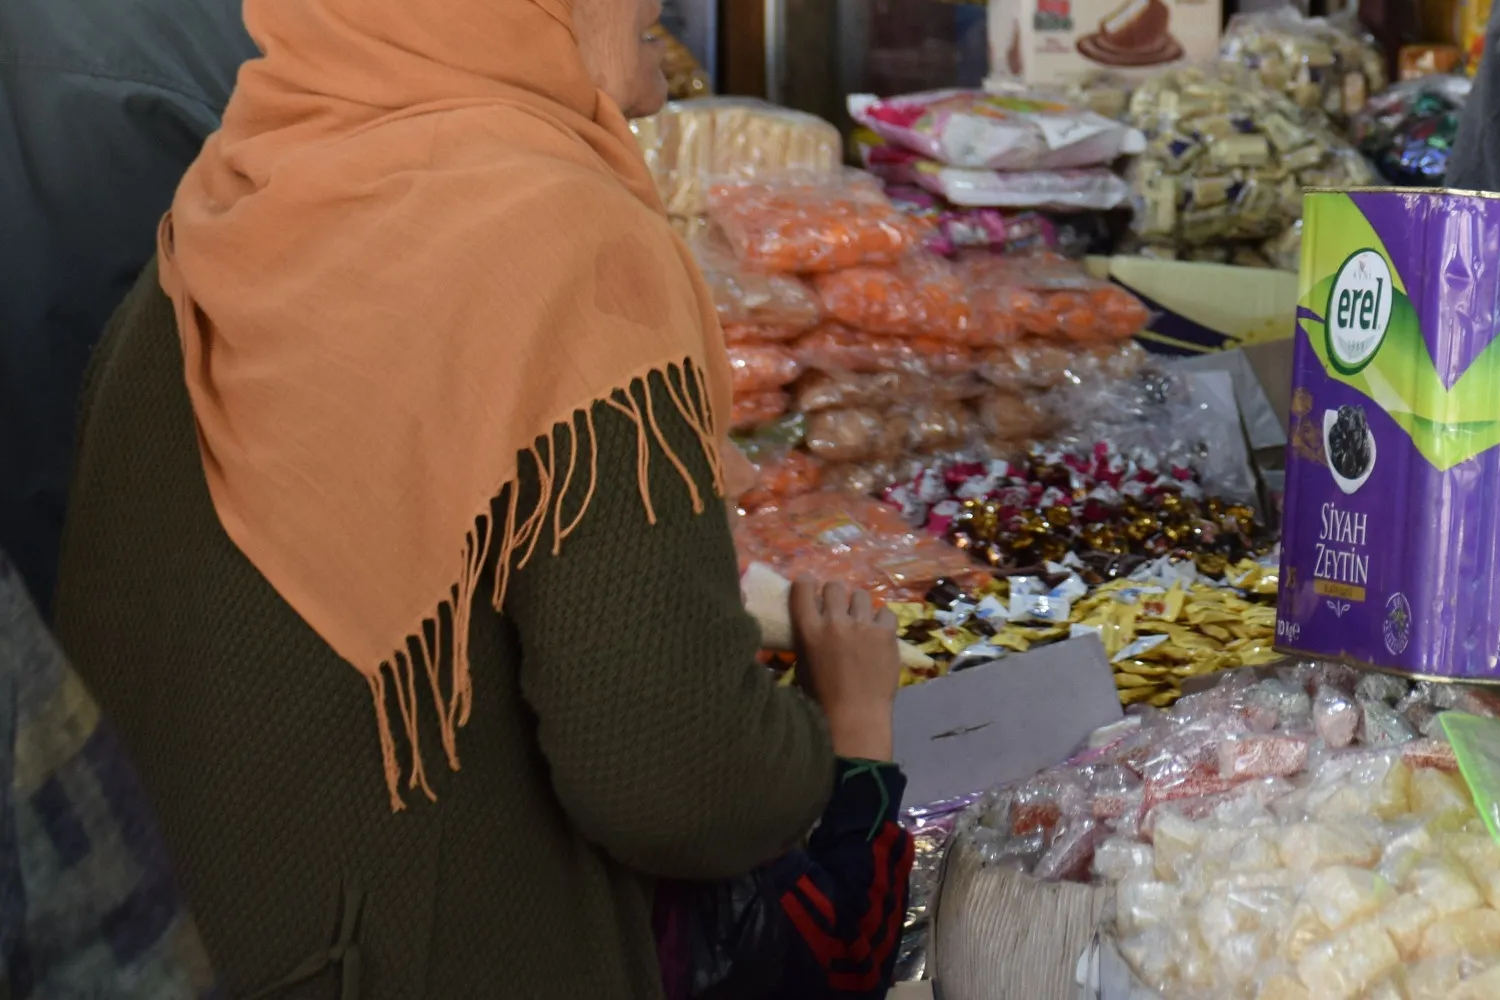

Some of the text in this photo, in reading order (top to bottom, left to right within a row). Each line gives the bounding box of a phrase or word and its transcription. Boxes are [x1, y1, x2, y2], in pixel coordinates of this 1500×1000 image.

[1337, 277, 1383, 330] erel
[1319, 502, 1367, 545] SİYAH
[1313, 543, 1369, 585] ZEYTİN
